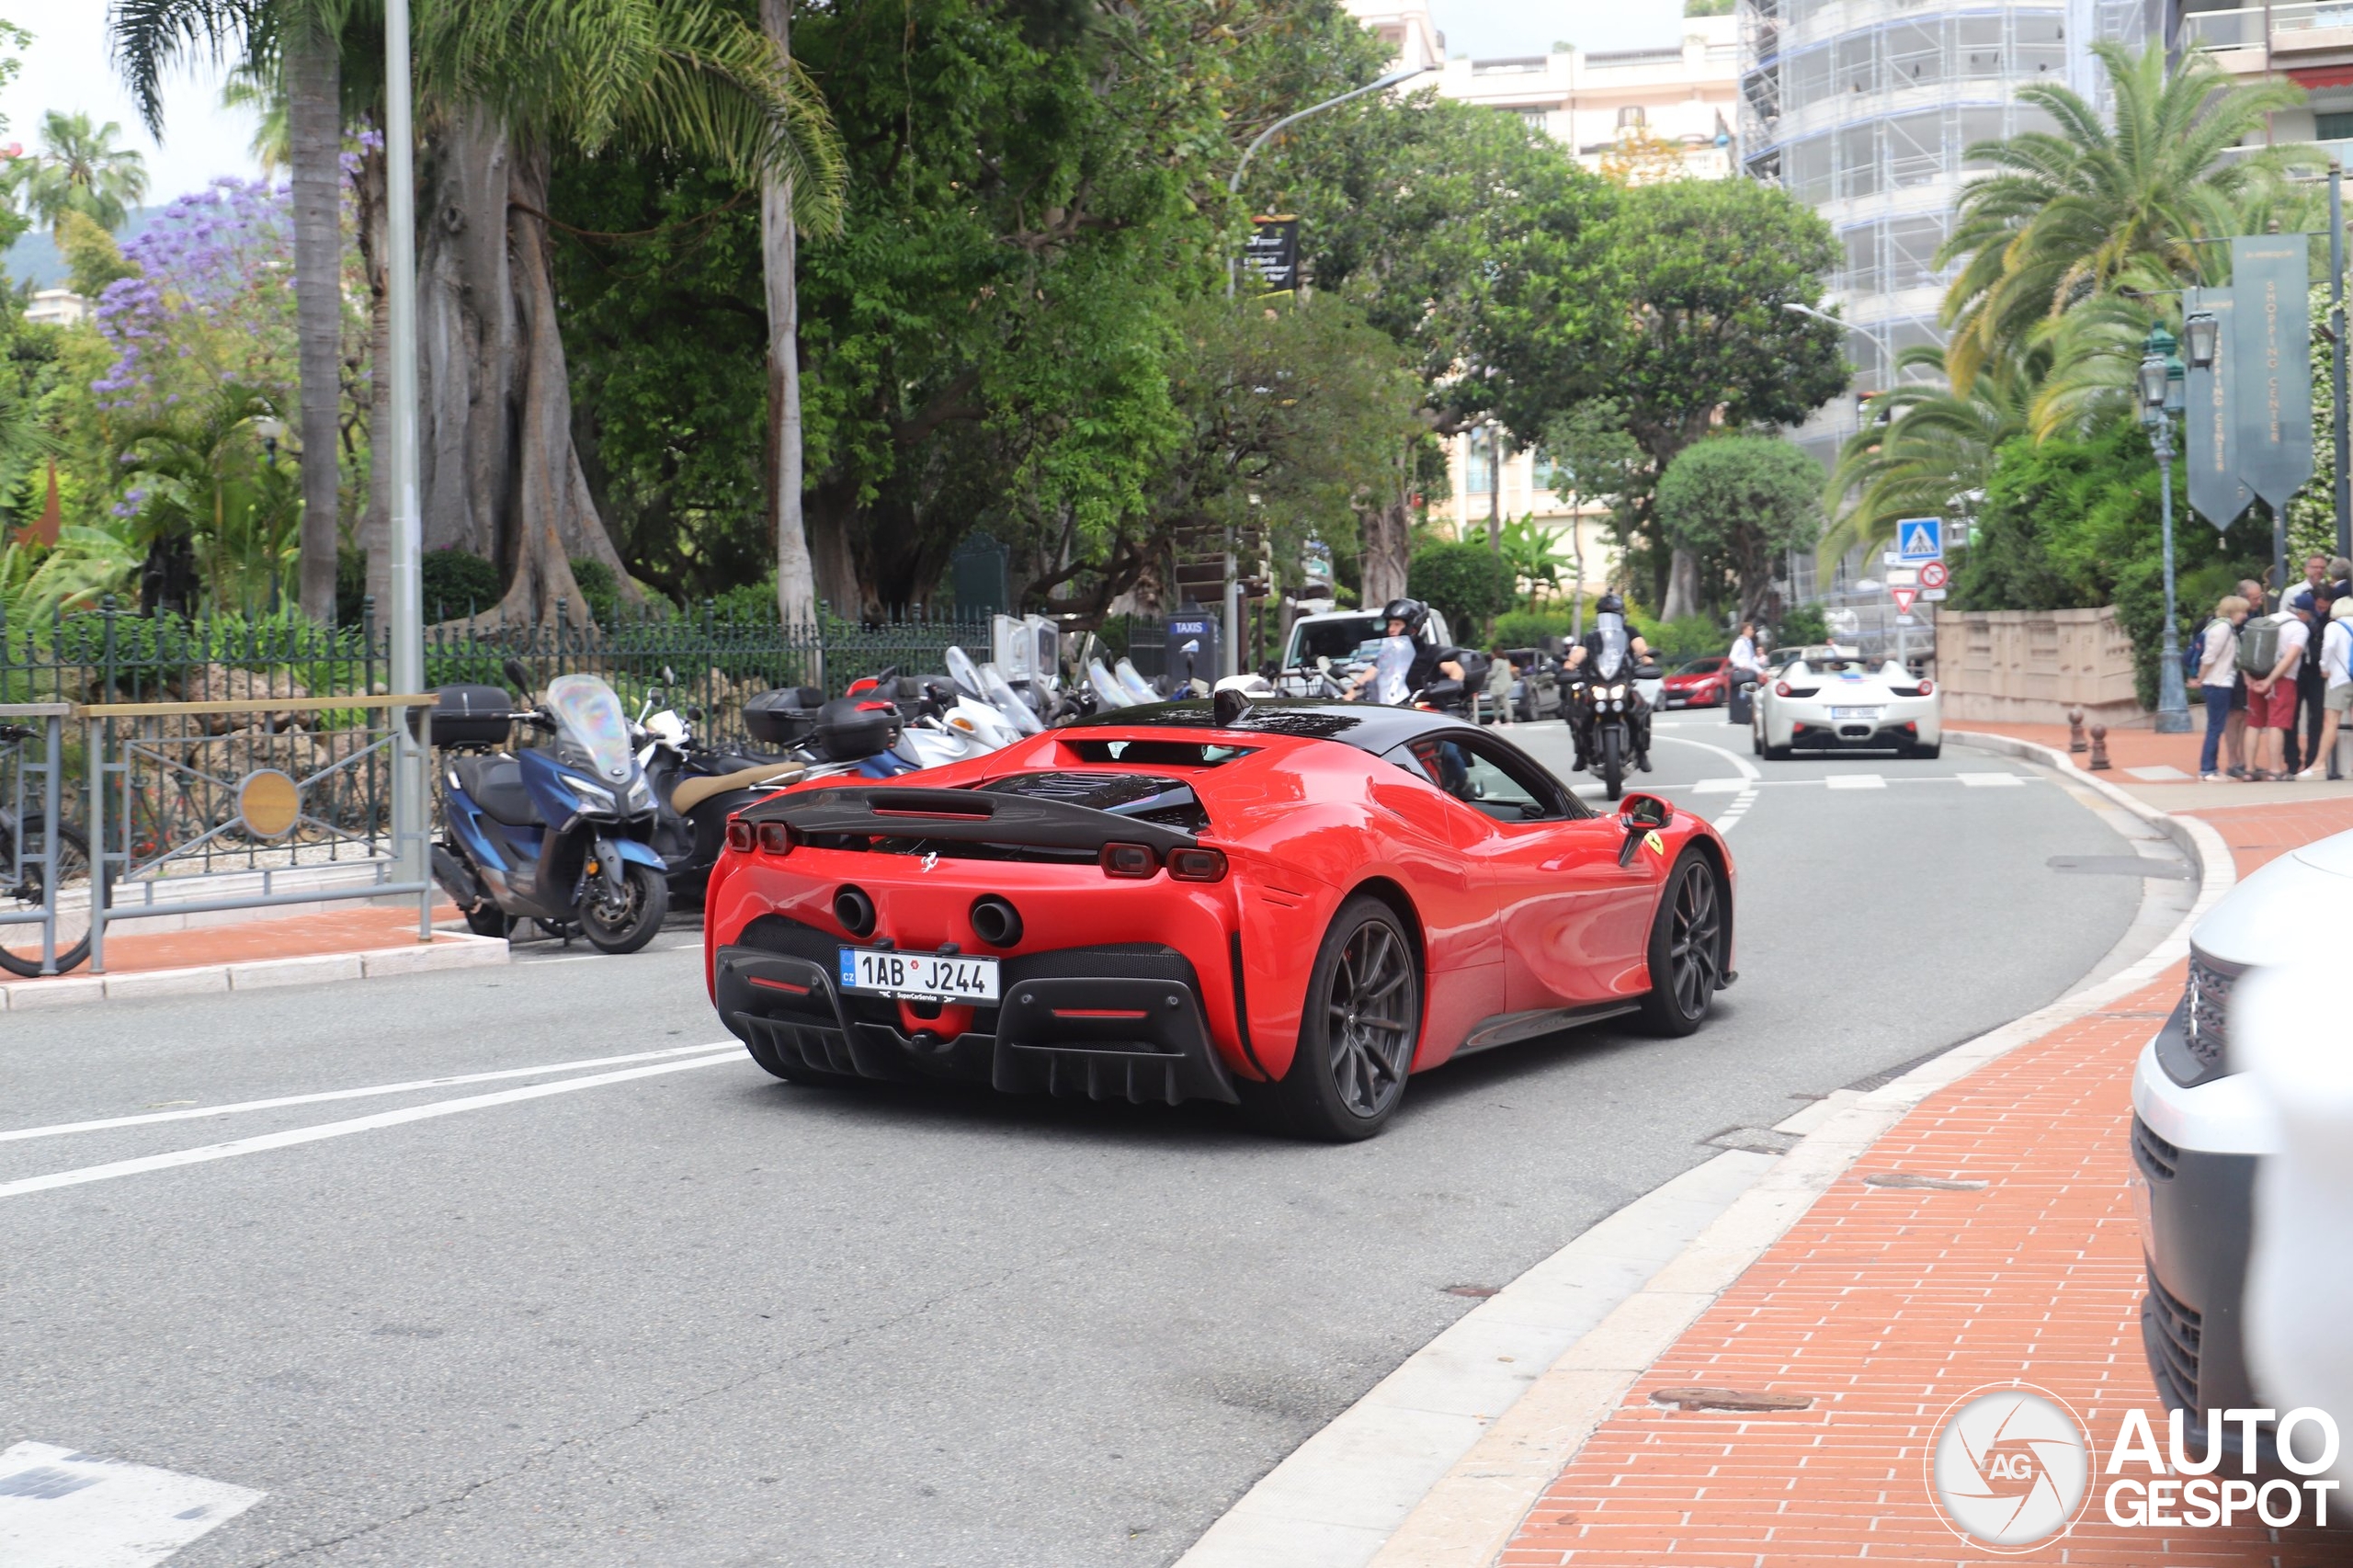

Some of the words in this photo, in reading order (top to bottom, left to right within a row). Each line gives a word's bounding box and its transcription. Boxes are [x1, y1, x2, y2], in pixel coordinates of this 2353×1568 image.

[2266, 281, 2279, 369] SHOPPING
[2268, 377, 2280, 443] CENTER
[2214, 413, 2224, 472] CENTER
[1176, 621, 1203, 633] TAXIS
[843, 972, 855, 982] CZ
[862, 956, 904, 986] 1AB
[925, 961, 985, 994] J244
[896, 992, 938, 1002] SuperCarService
